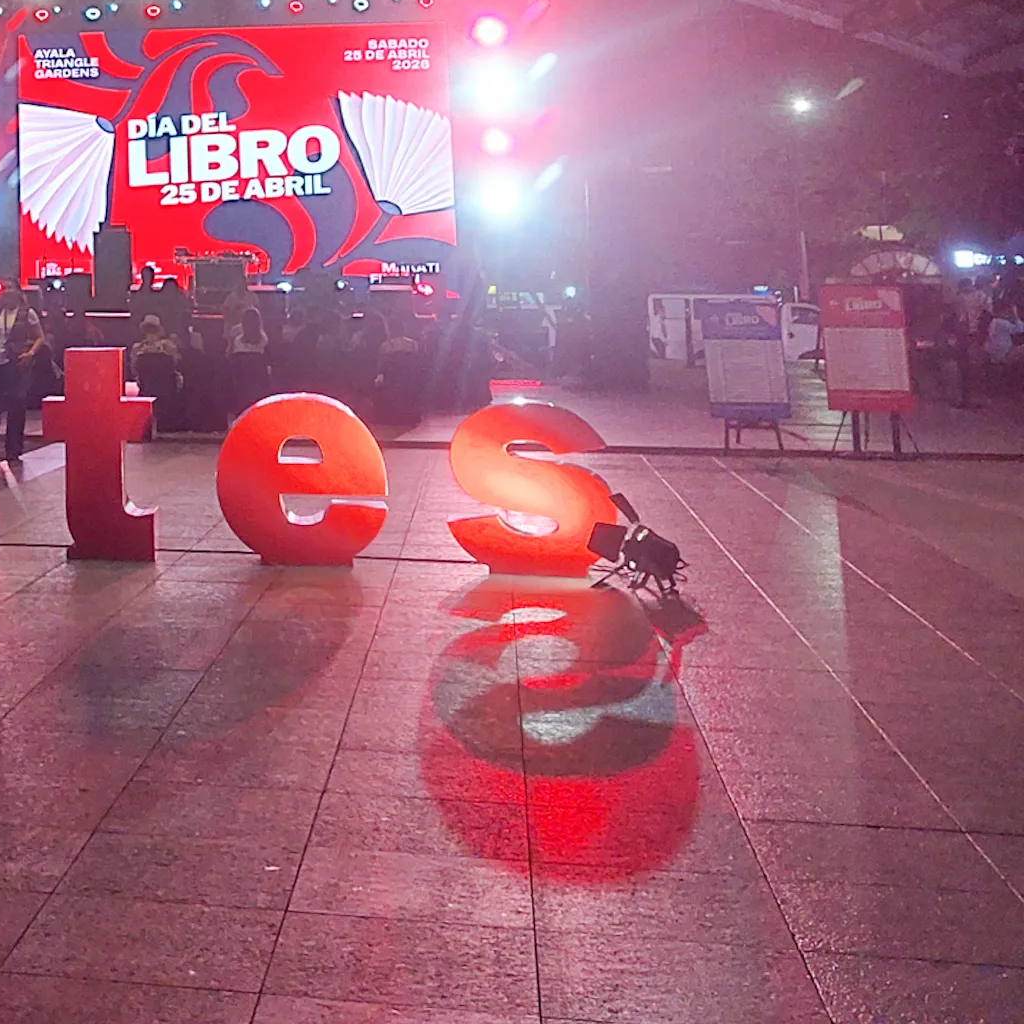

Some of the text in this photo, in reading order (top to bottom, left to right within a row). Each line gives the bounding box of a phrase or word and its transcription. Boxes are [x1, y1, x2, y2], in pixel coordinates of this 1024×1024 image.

[368, 38, 429, 49] SABADO
[34, 48, 75, 58] AYALA
[344, 48, 430, 61] 25 DE ABRIL
[34, 57, 99, 68] TRIANGLE
[392, 59, 430, 71] 2026
[34, 67, 99, 79] GARDENS
[128, 112, 236, 139] DÍA DEL
[128, 125, 340, 187] LIBRO
[160, 174, 331, 205] 25 DE ABRIL
